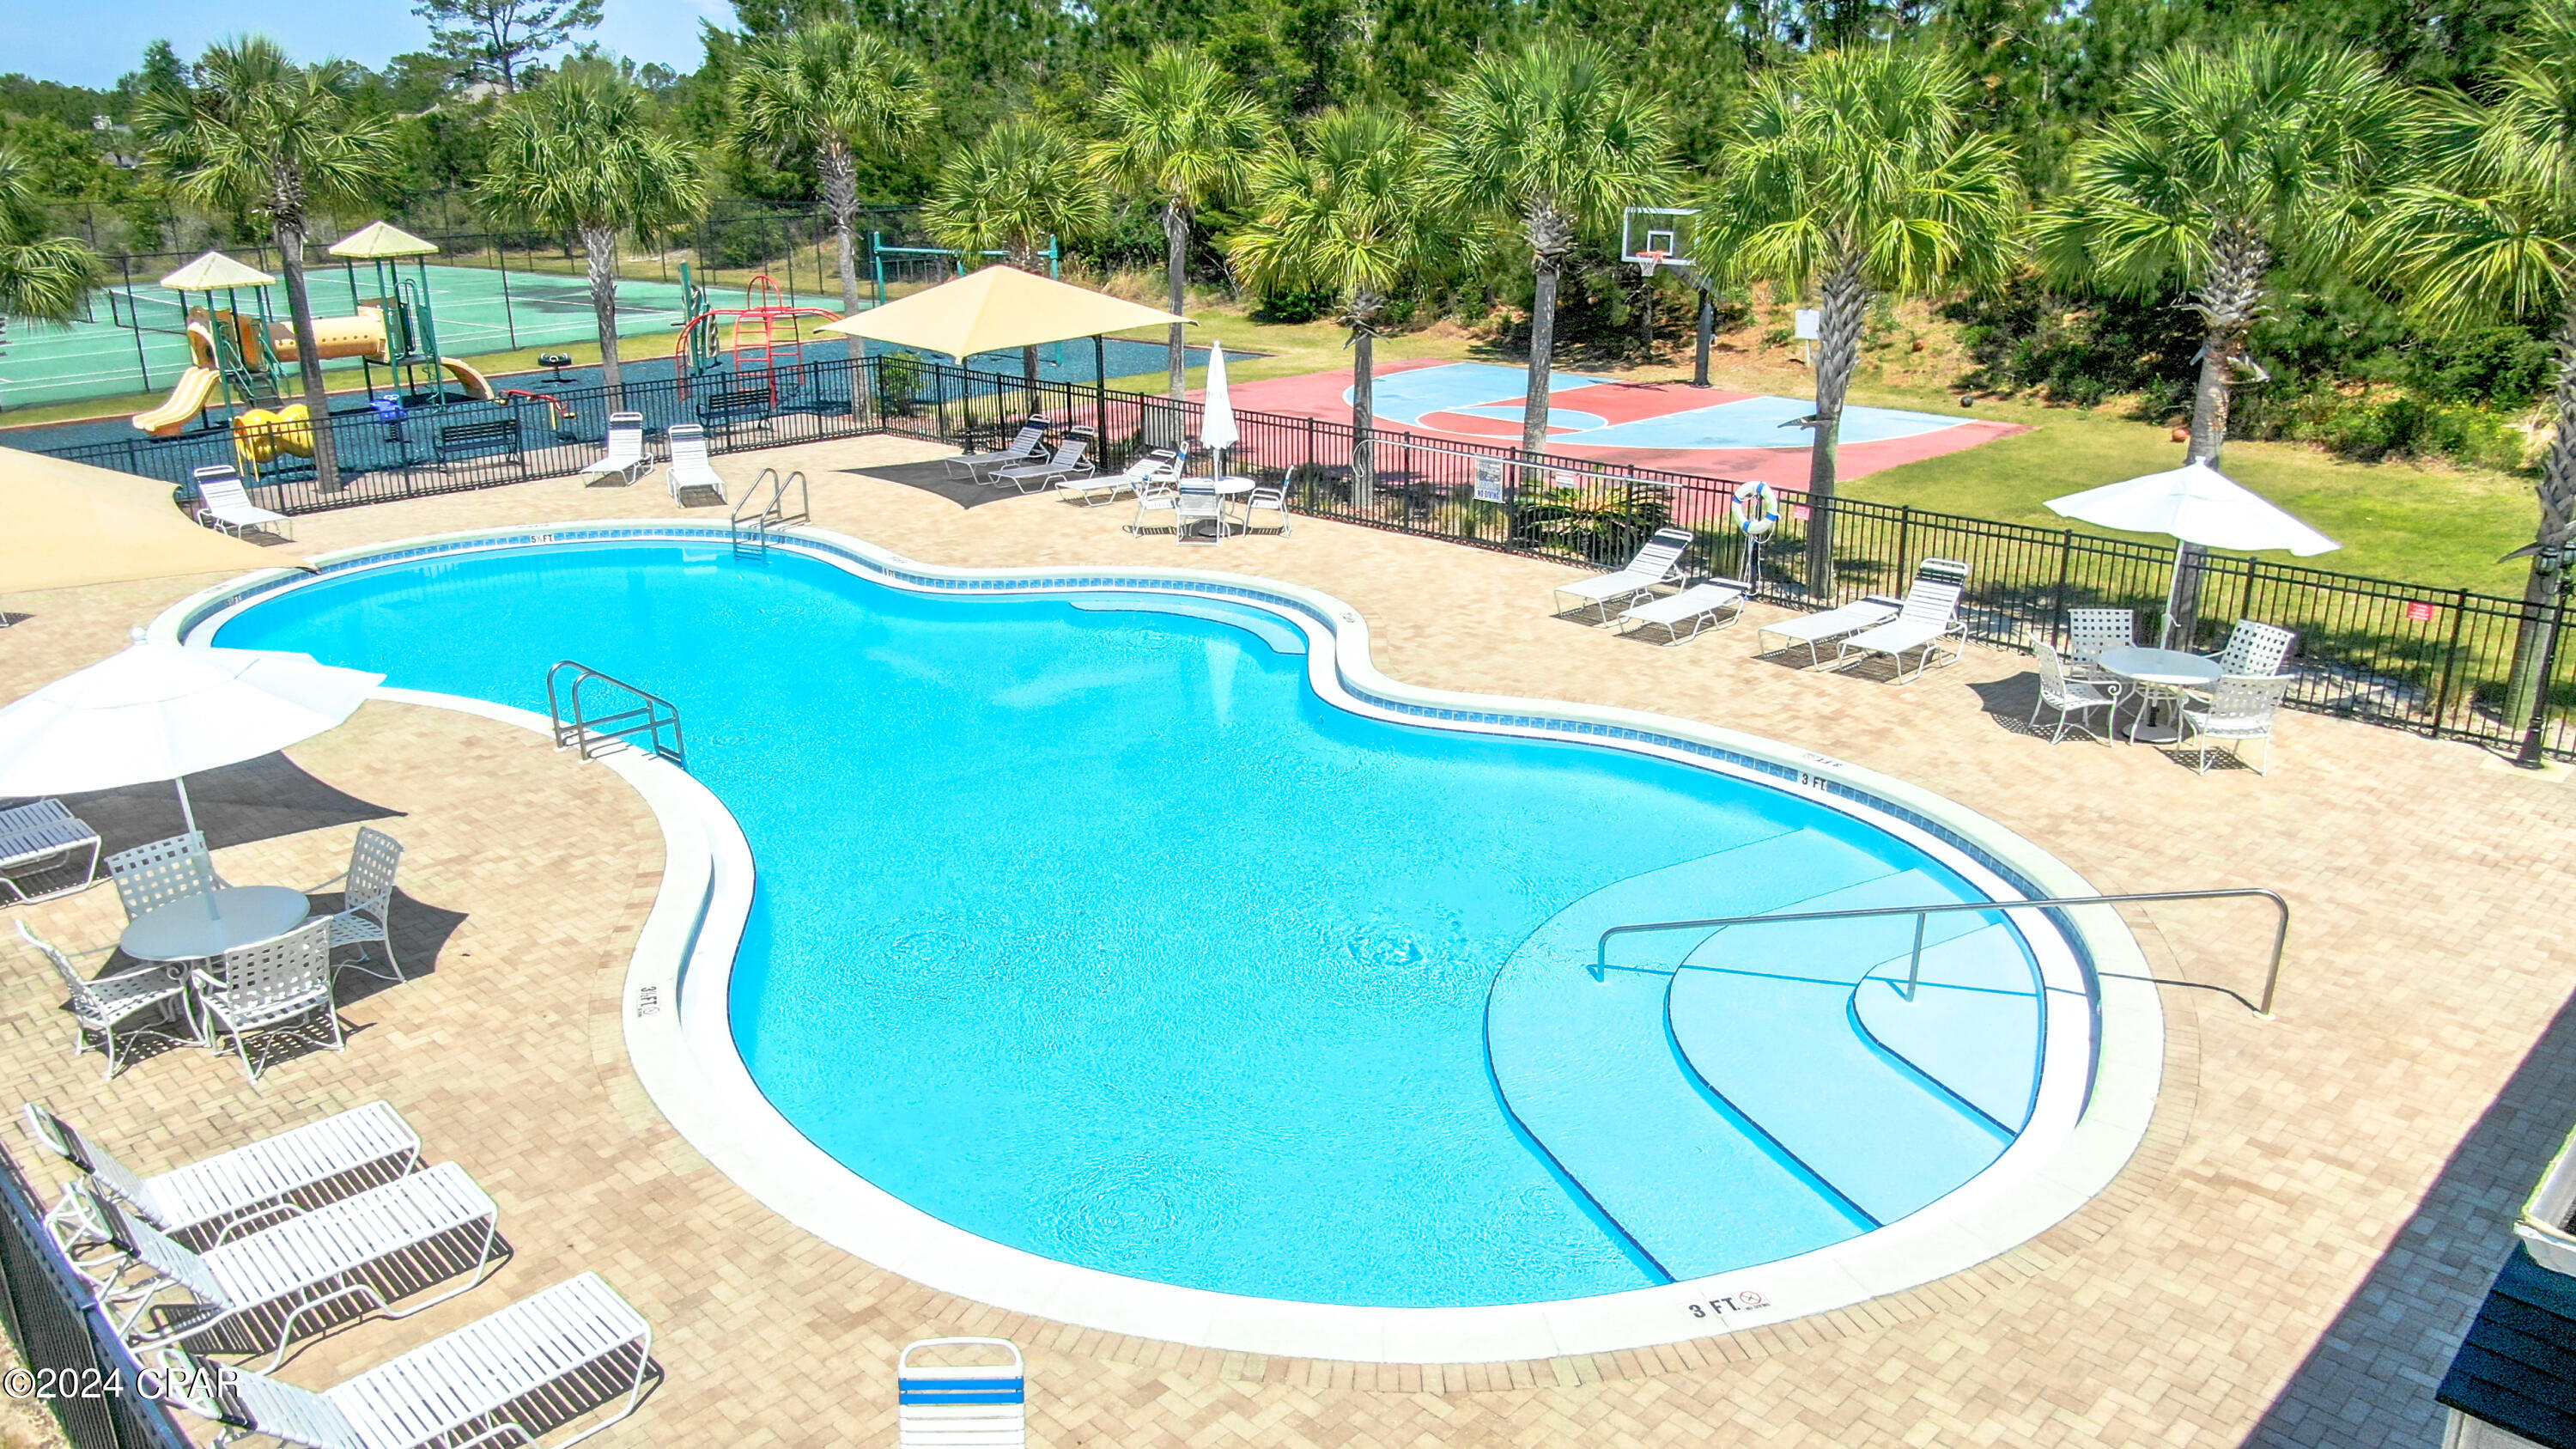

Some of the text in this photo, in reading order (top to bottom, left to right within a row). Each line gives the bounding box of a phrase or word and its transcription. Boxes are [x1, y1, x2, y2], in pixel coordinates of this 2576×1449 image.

[1801, 773, 1826, 790] 3 FT
[1688, 1304, 1706, 1318] 3
